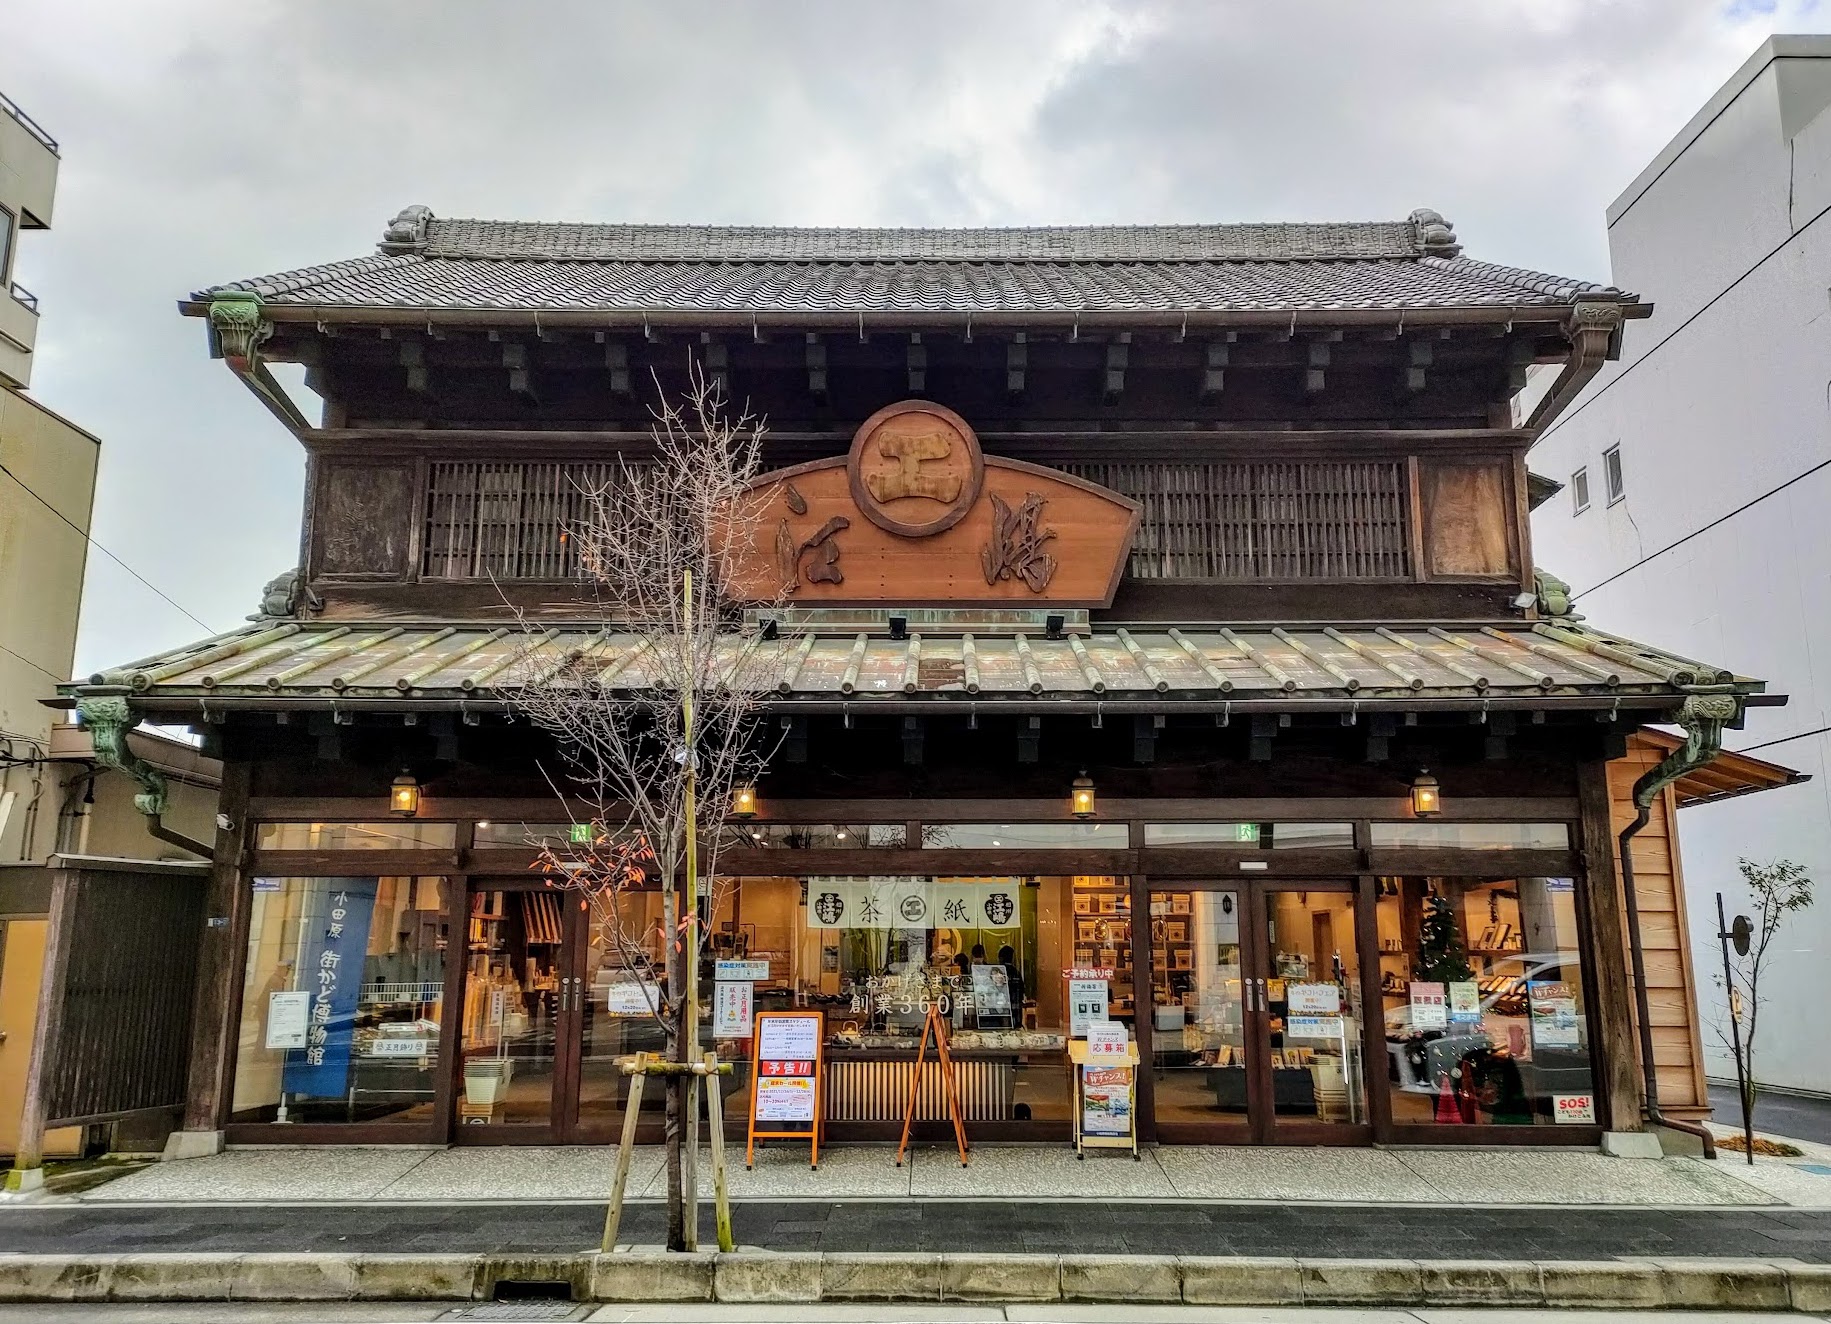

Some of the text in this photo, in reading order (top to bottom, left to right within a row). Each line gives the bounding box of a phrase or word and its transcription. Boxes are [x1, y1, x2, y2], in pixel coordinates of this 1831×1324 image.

[858, 895, 884, 924] 茶
[943, 898, 971, 924] 紙
[306, 890, 348, 1066] 小田原 街かど博物館
[1062, 968, 1114, 979] ご予約承り中
[865, 974, 961, 990] おかげさまで
[740, 985, 748, 1023] お正月用品
[848, 994, 975, 1016] 創業360年
[1092, 1043, 1125, 1053] 応募箱
[768, 1061, 809, 1075] 予告!!
[1559, 1096, 1590, 1110] SOS!
